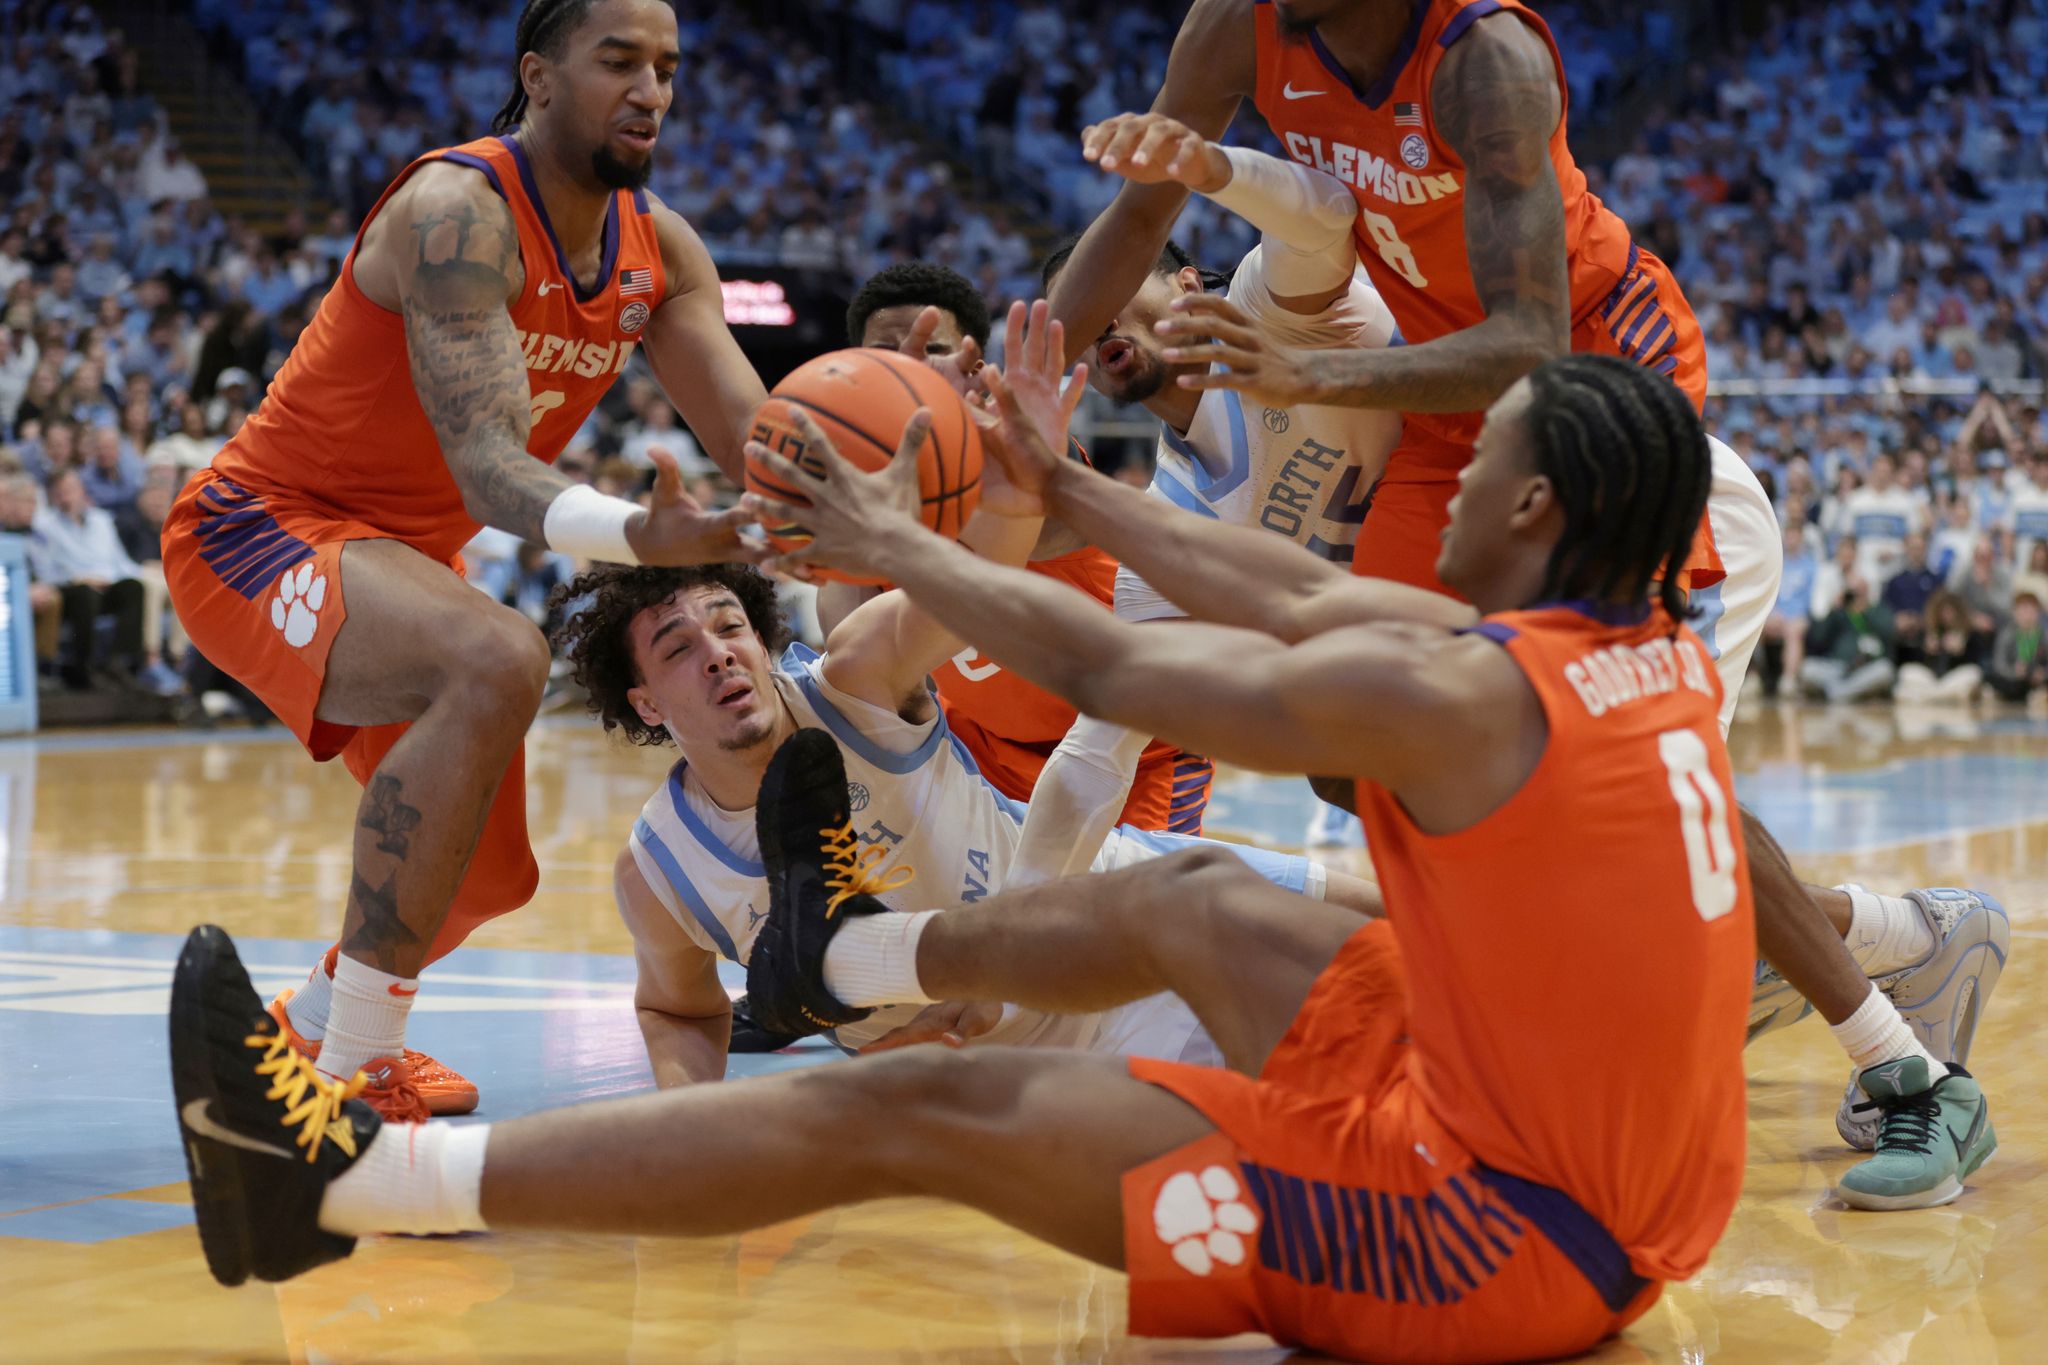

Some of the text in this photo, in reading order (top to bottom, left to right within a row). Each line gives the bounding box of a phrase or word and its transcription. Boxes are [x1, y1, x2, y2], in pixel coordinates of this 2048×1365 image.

[1285, 131, 1461, 205] CLEMSON
[1363, 207, 1428, 288] 8
[1260, 438, 1346, 537] ORTH
[1658, 728, 1738, 922] 0
